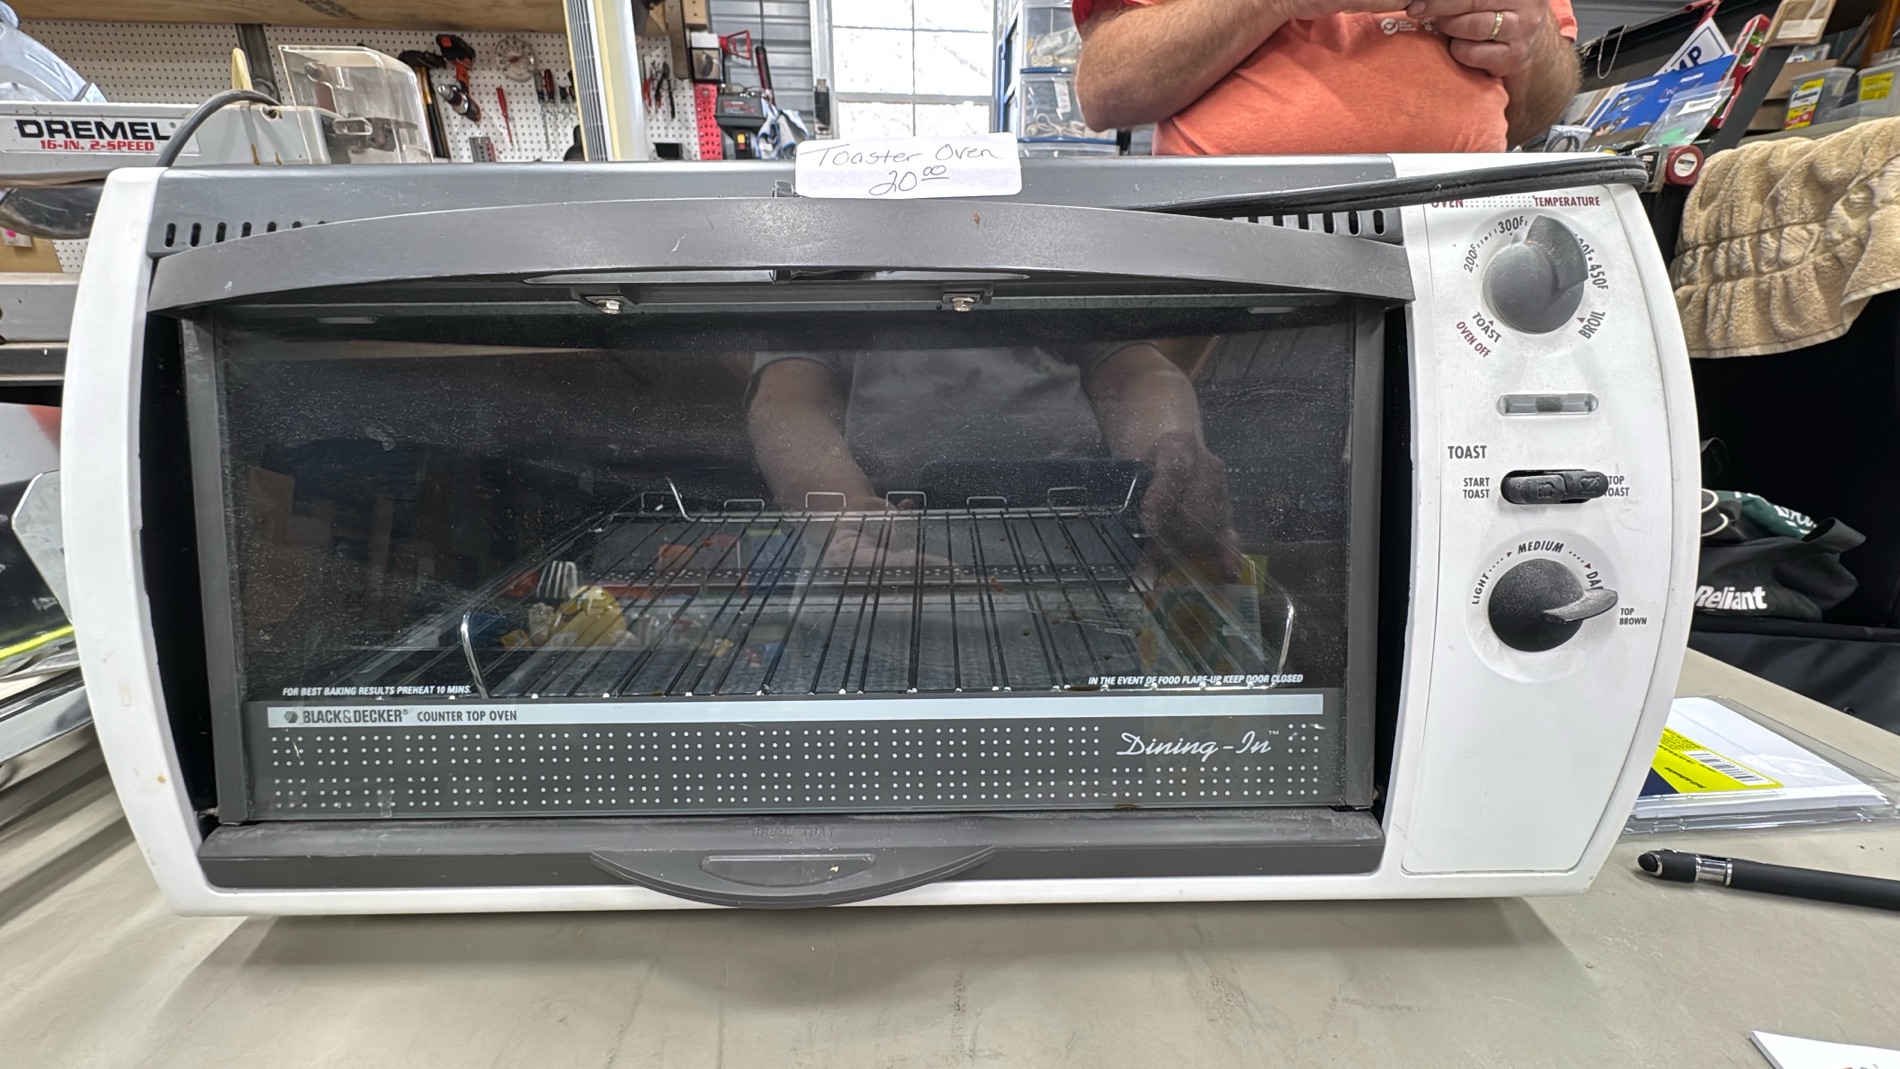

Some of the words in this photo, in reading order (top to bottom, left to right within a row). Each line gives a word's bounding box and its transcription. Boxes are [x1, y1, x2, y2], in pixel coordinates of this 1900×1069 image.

[15, 119, 172, 141] DREMEL
[40, 139, 85, 150] 16-IN.
[90, 140, 155, 151] 2-SPEED
[801, 143, 922, 167] Toaster
[935, 143, 1003, 162] Oven
[1534, 196, 1601, 207] TEMPERATURE
[1497, 215, 1525, 234] 300F
[1463, 243, 1478, 273] 200F
[1589, 264, 1609, 290] 450F
[1471, 311, 1502, 344] TOAST
[1577, 311, 1606, 340] BROIL
[1456, 321, 1476, 346] OVEN
[1474, 341, 1492, 358] OFF
[1447, 445, 1487, 459] TOAST
[1463, 477, 1490, 487] START
[1463, 489, 1490, 498] TOAST
[1605, 487, 1630, 497] OAST
[1517, 540, 1564, 554] MEDIUM
[1471, 572, 1490, 605] LIGHT
[1695, 585, 1768, 611] Reliant
[1620, 607, 1635, 616] TOP
[1619, 617, 1647, 626] BROWN
[1087, 676, 1099, 685] IN
[1099, 676, 1117, 685] THE
[1117, 676, 1145, 685] EVENT
[1145, 675, 1158, 685] OF
[1158, 675, 1181, 684] FOOD
[1223, 675, 1245, 684] KEEP
[1245, 674, 1270, 683] DOOR
[1270, 674, 1304, 683] CLOSED
[282, 687, 299, 696] FOR
[300, 686, 322, 696] BEST
[323, 686, 357, 696] BAKING
[358, 686, 395, 695] RESULTS
[396, 685, 435, 695] PREHEAT
[436, 685, 445, 694] 10
[446, 685, 472, 694] MINS.
[417, 711, 463, 722] COUNTER
[466, 710, 487, 721] TOP
[489, 710, 518, 721] OVEN
